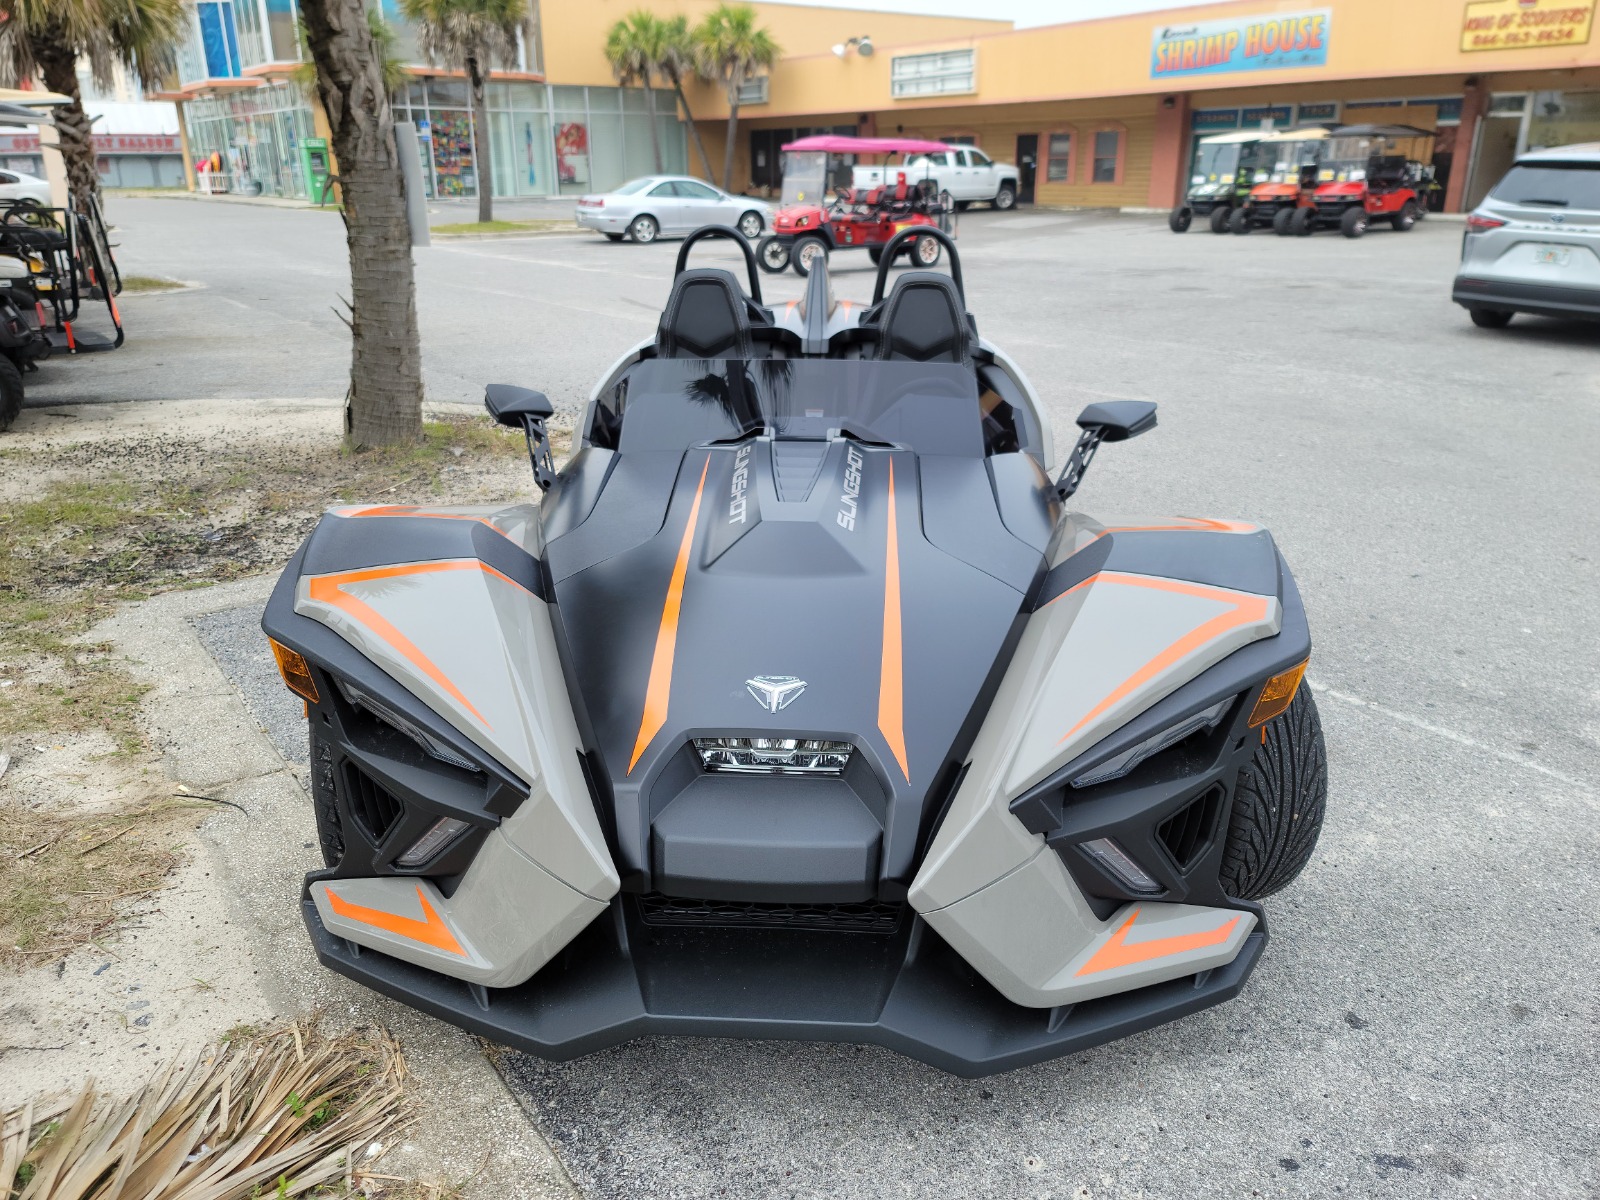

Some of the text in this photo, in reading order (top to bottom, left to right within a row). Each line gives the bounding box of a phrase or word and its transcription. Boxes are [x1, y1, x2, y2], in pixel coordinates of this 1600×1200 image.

[1155, 15, 1325, 73] SHRIMP HOUSE
[729, 445, 751, 524] SLINGSHOT
[836, 446, 863, 531] SLINGSHOT
